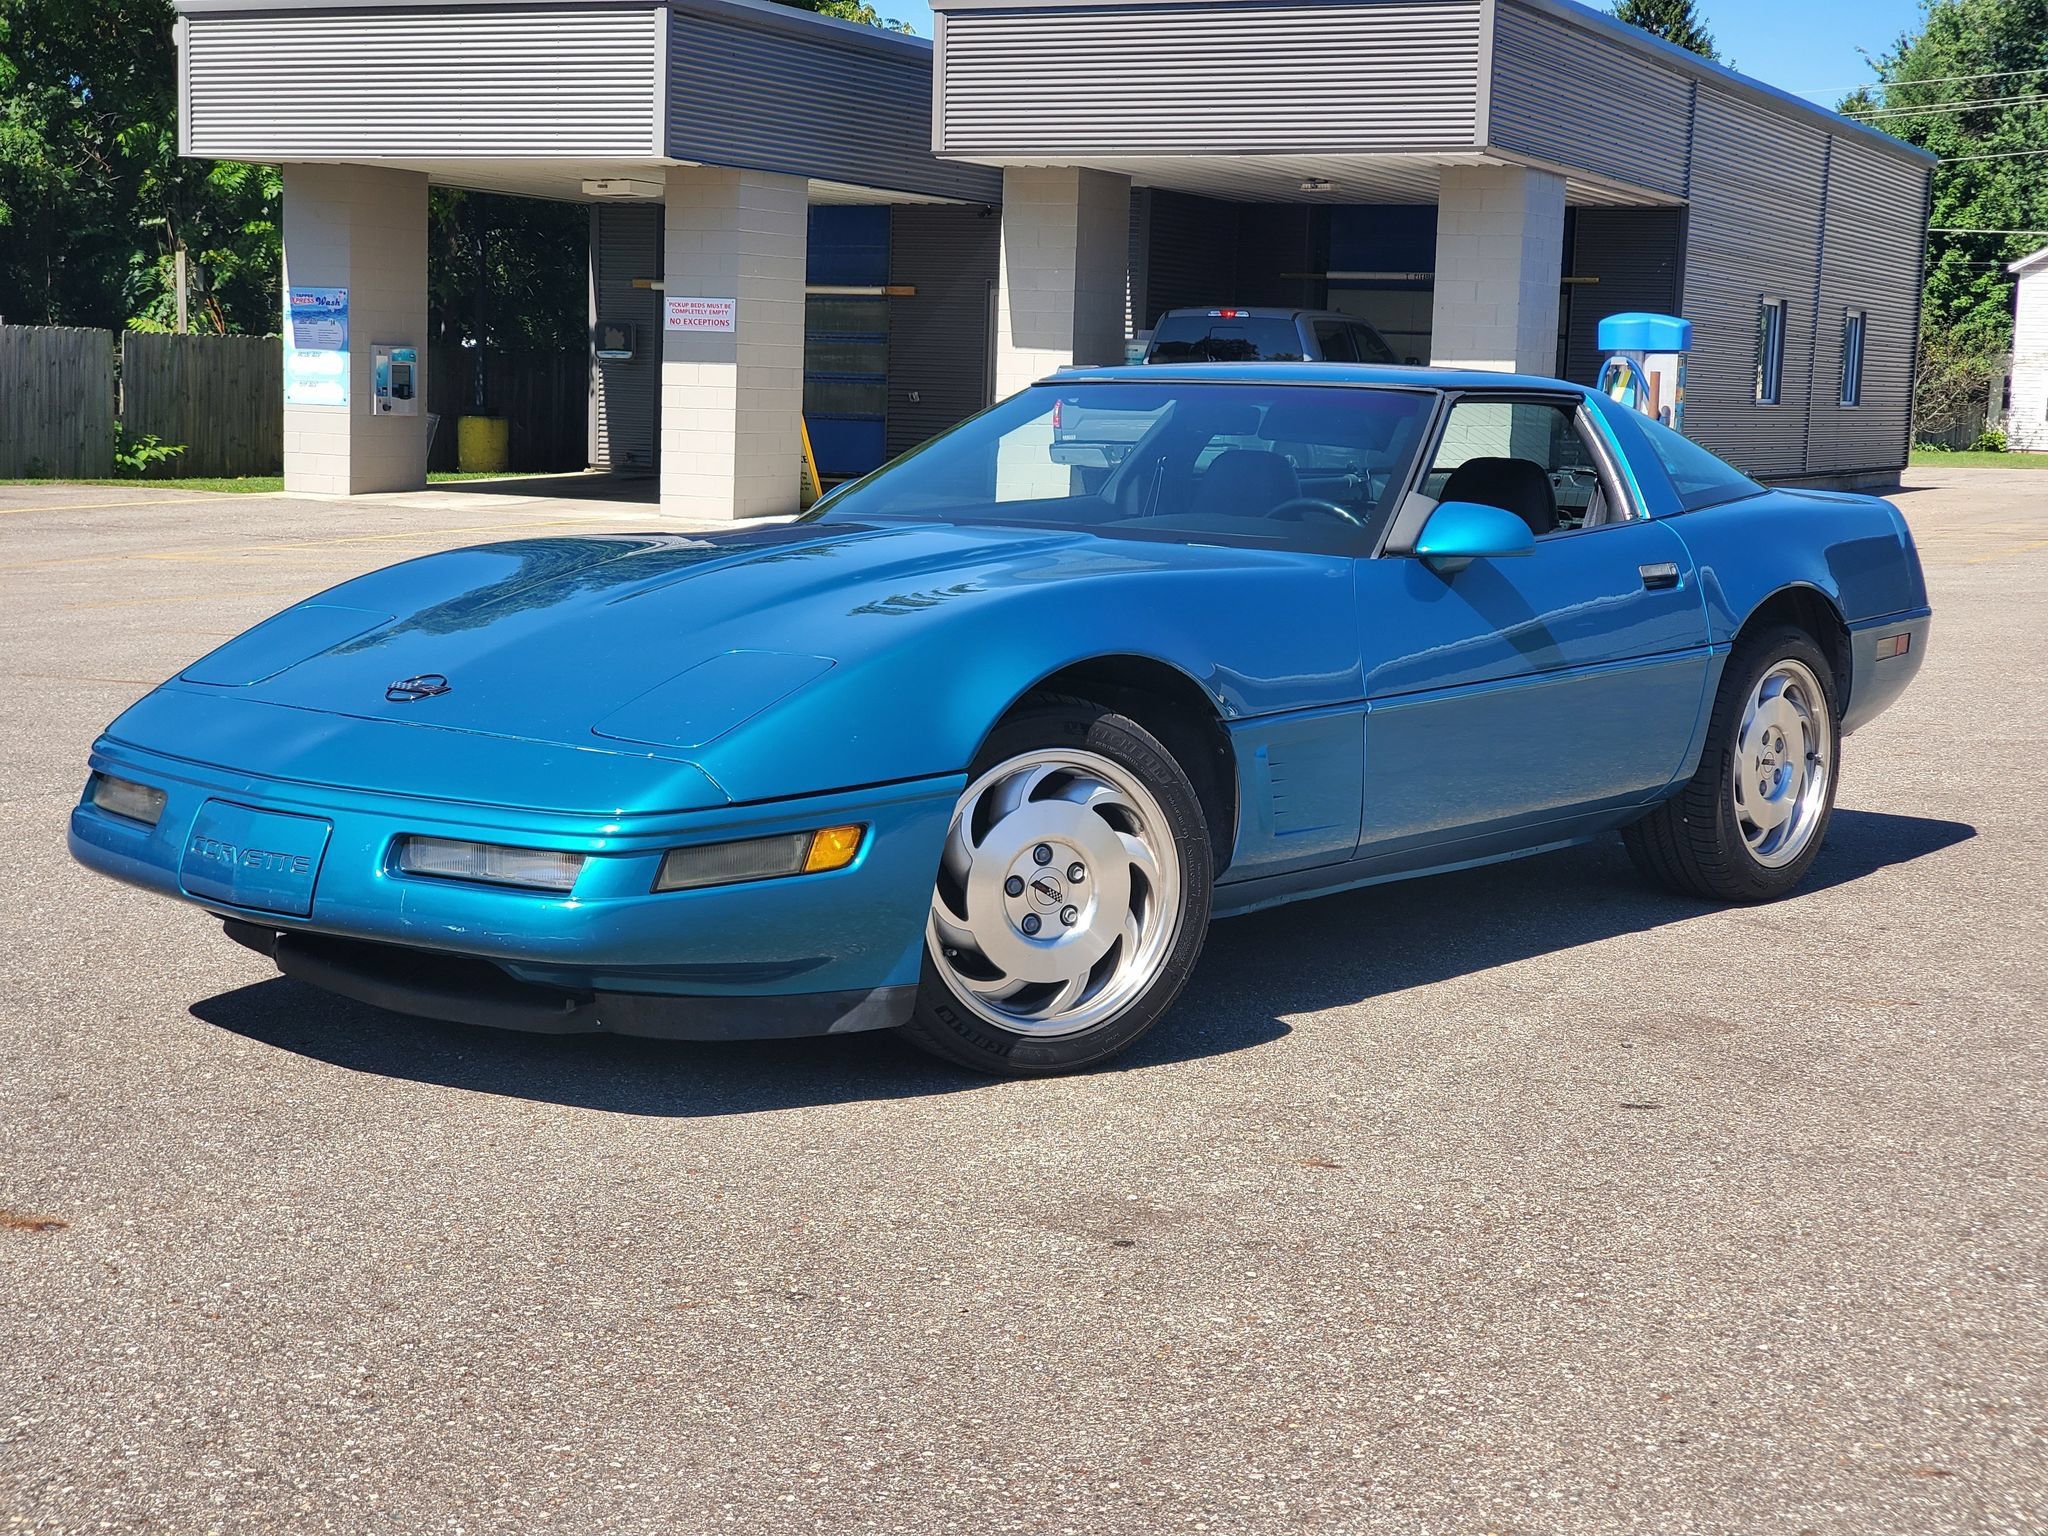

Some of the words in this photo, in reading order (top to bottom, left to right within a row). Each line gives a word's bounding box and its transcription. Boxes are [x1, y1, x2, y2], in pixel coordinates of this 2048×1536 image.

[315, 296, 340, 306] Wash
[683, 318, 730, 326] EXCEPTIONS
[190, 835, 312, 875] CORVETTE
